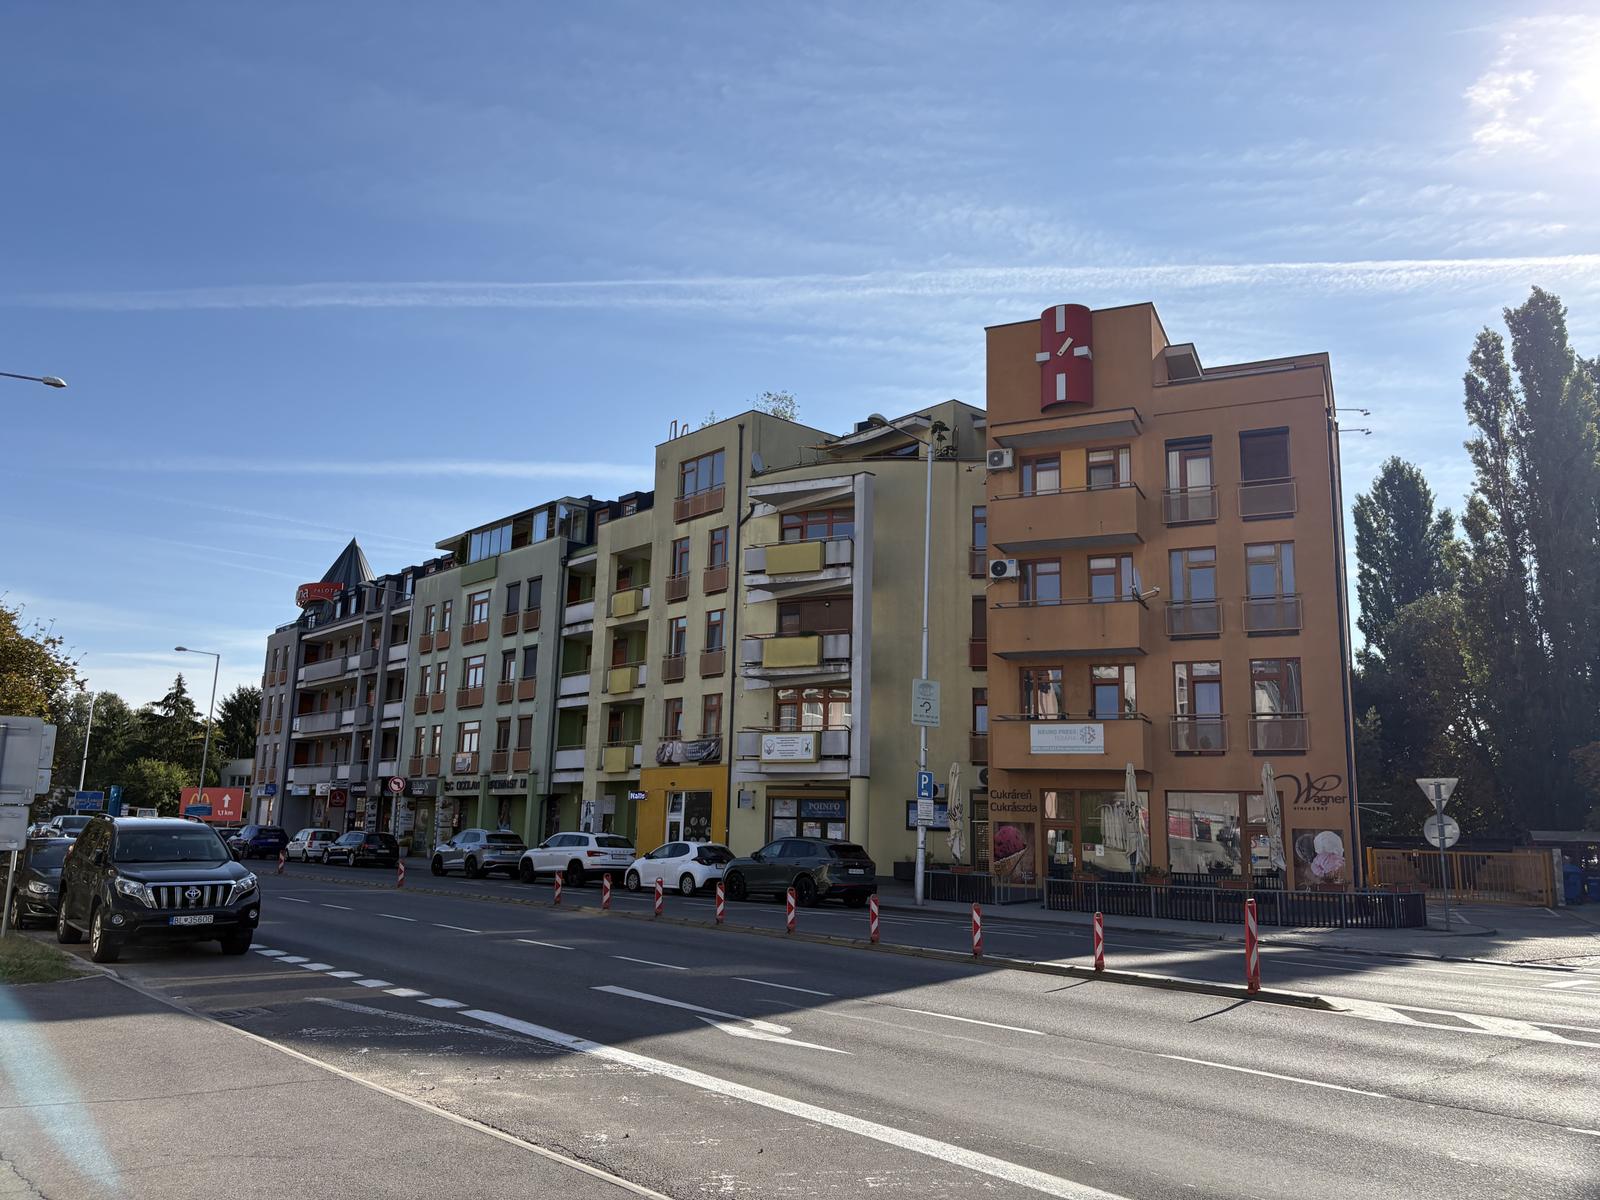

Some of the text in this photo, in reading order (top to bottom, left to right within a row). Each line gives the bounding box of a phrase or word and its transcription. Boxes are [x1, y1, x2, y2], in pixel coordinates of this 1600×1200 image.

[921, 774, 929, 789] P
[990, 788, 1032, 800] Cukráreň
[1273, 772, 1348, 805] Wagner
[990, 801, 1038, 813] Cukrászda
